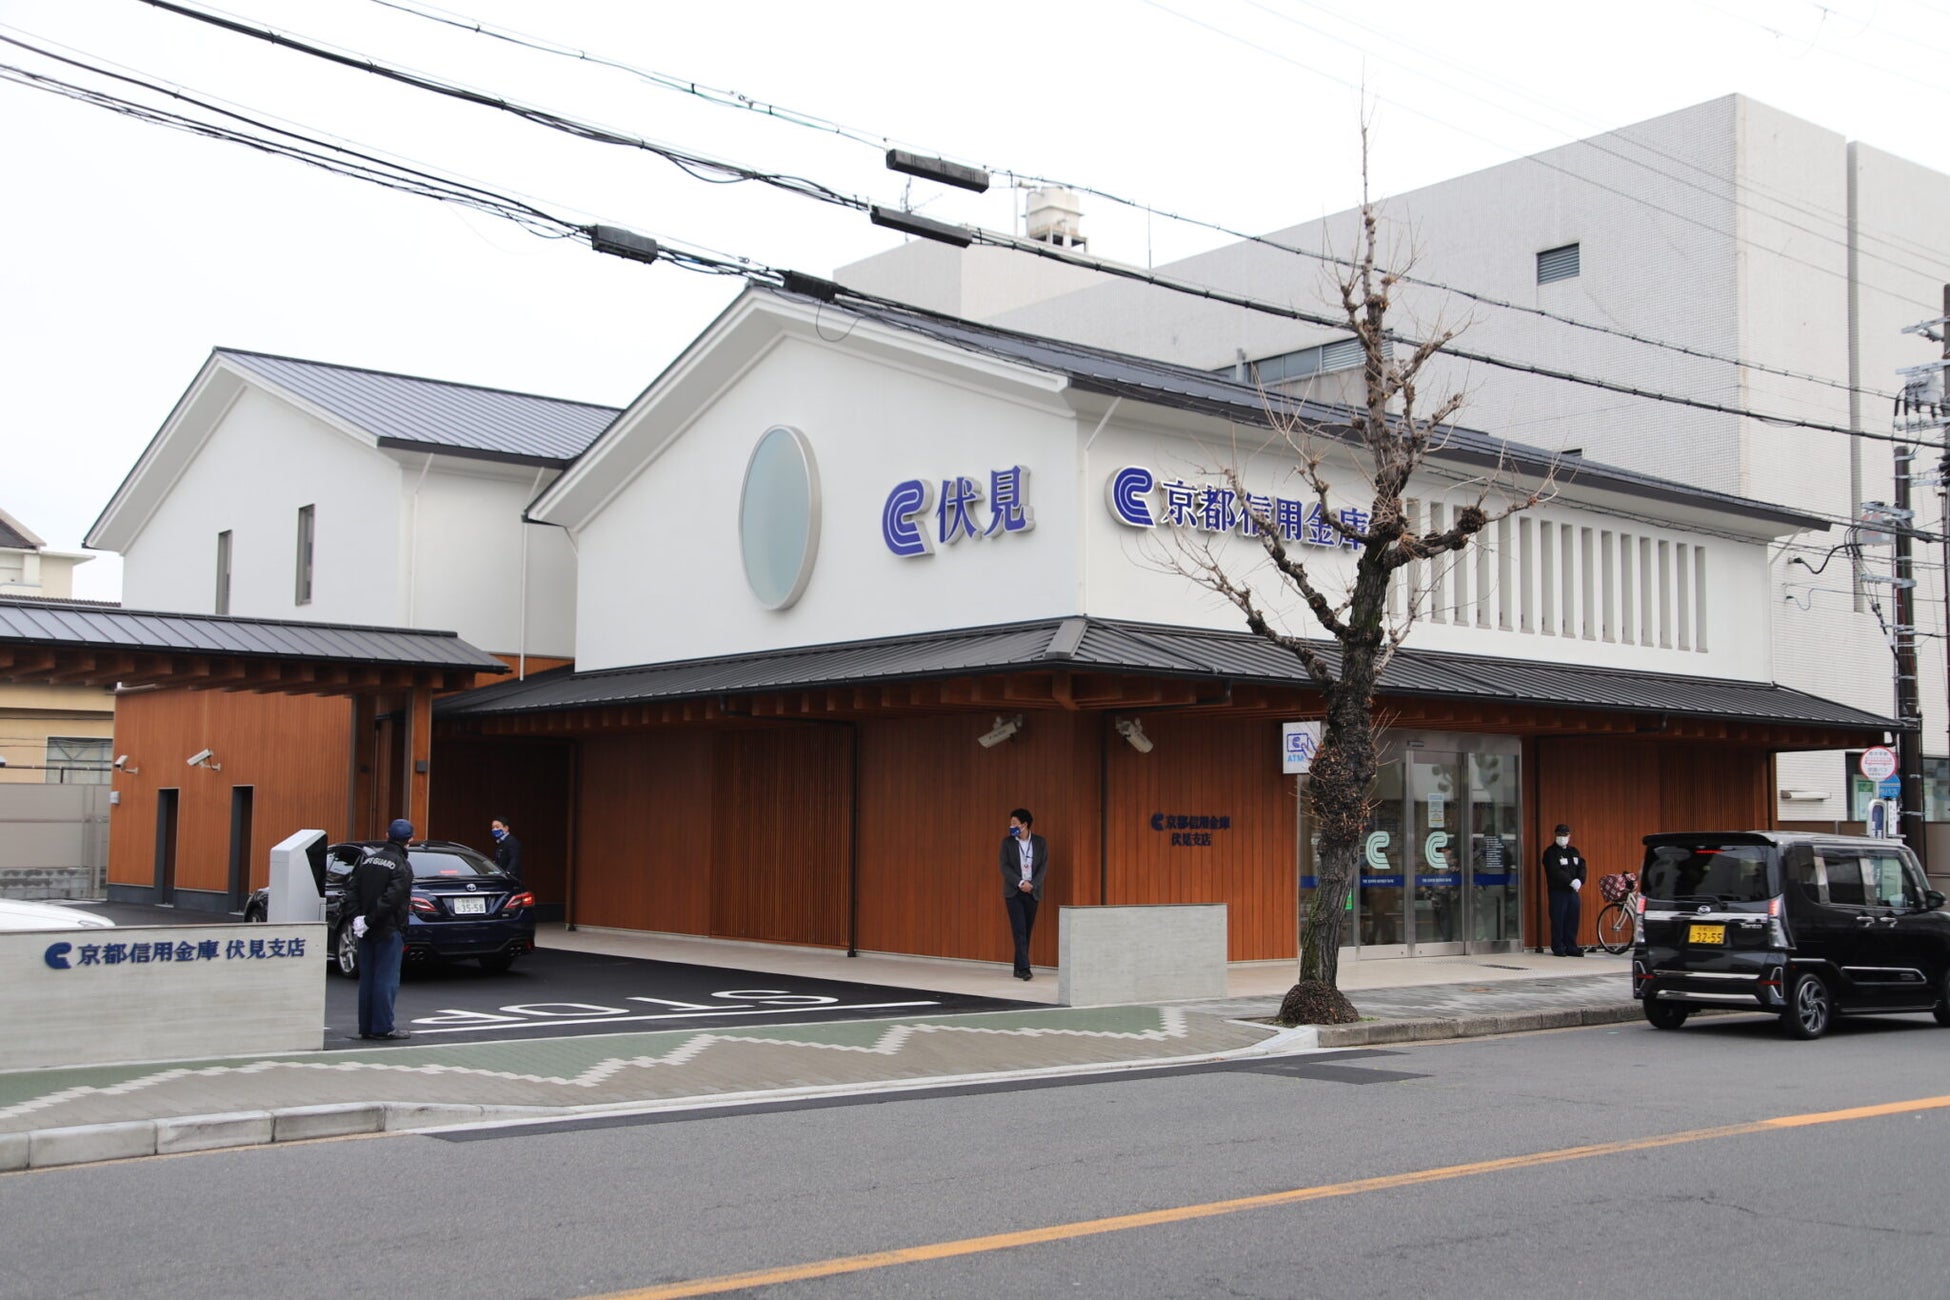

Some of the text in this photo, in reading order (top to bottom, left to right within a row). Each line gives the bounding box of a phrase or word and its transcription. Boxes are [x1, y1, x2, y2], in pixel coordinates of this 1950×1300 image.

[935, 464, 1032, 546] 伏見
[1287, 754, 1305, 763] ATM
[77, 940, 220, 966] 京都信用金庫
[226, 937, 306, 960] 伏見支店
[1696, 932, 1722, 943] 32-55
[411, 988, 839, 1025] STOP
